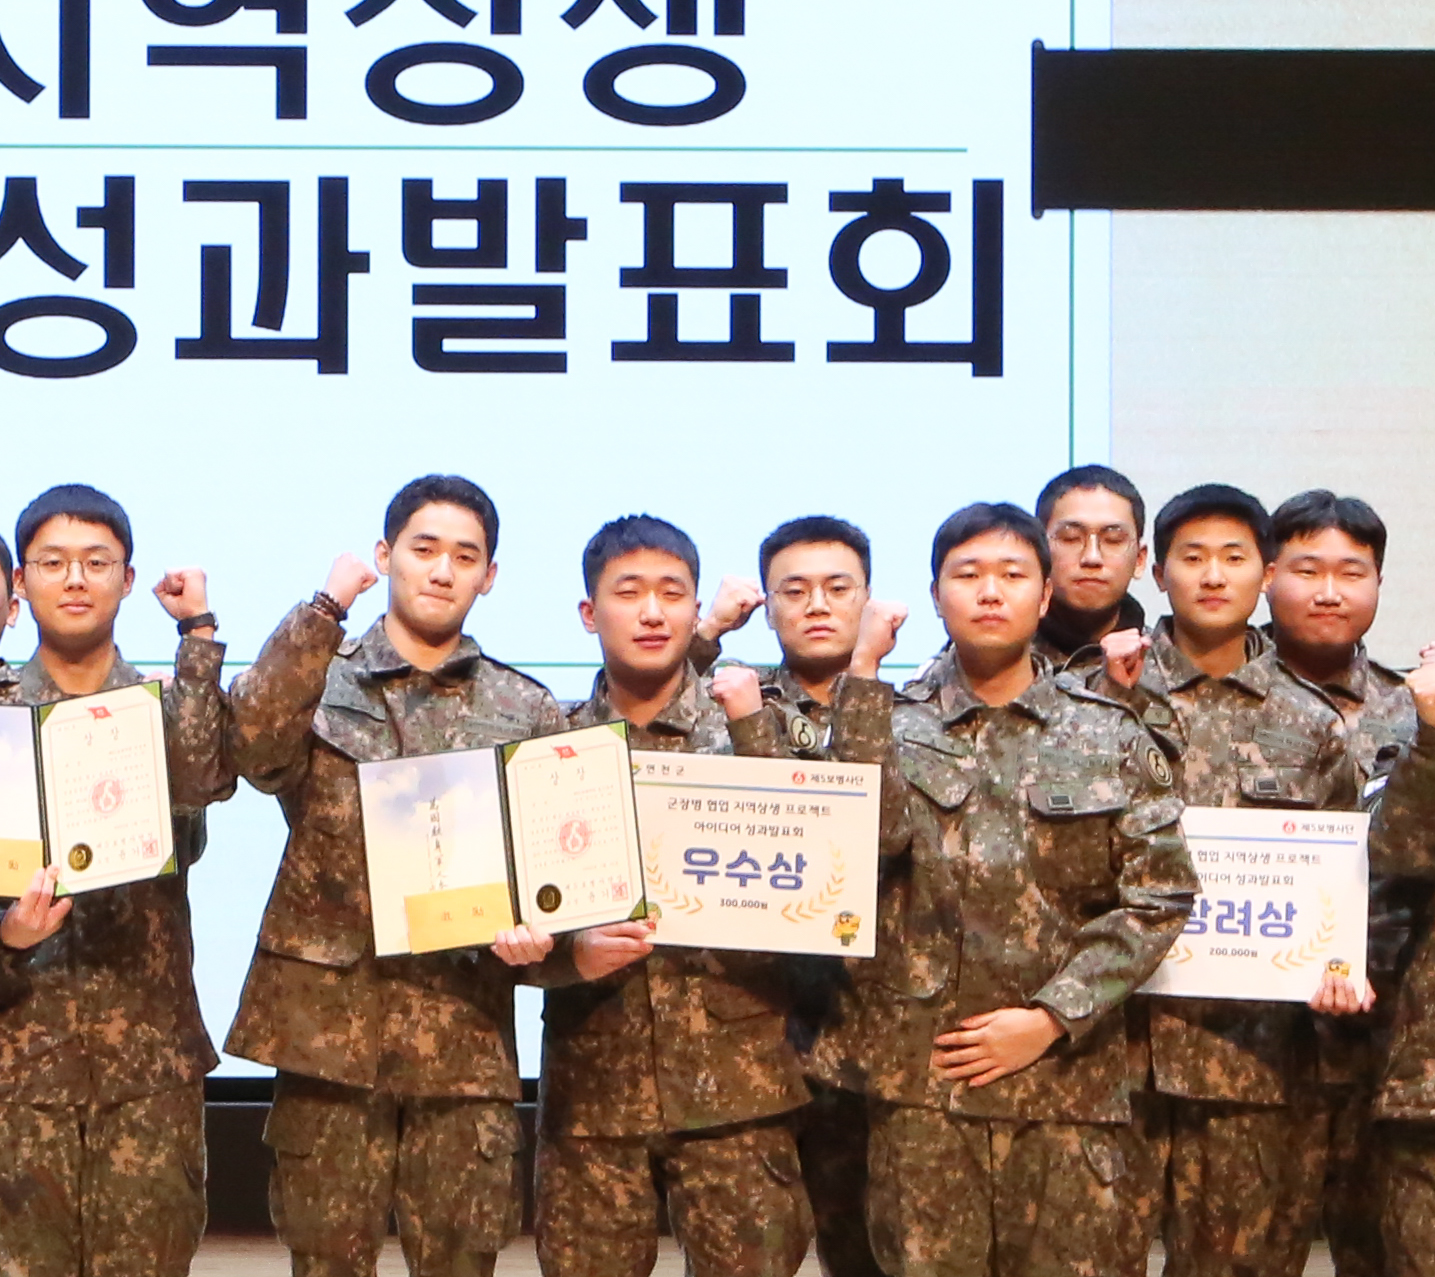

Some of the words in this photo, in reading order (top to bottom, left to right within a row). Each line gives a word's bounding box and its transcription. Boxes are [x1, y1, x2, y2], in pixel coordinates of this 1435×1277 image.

[810, 772, 864, 786] 제5보병사단
[667, 796, 703, 811] 군장병
[706, 798, 729, 814] 협업
[733, 800, 781, 815] 지역상생
[785, 803, 832, 818] 프로젝트
[693, 820, 742, 835] 아이디어
[745, 822, 805, 838] 성과발표회
[1300, 823, 1355, 836] 제5보병사단
[1197, 850, 1220, 863] 협업
[1224, 851, 1271, 865] 지역상생
[1275, 852, 1322, 866] 프로젝트
[681, 846, 808, 891] 우수상
[1197, 872, 1231, 885] 이디어
[1235, 872, 1294, 886] 성과발표회
